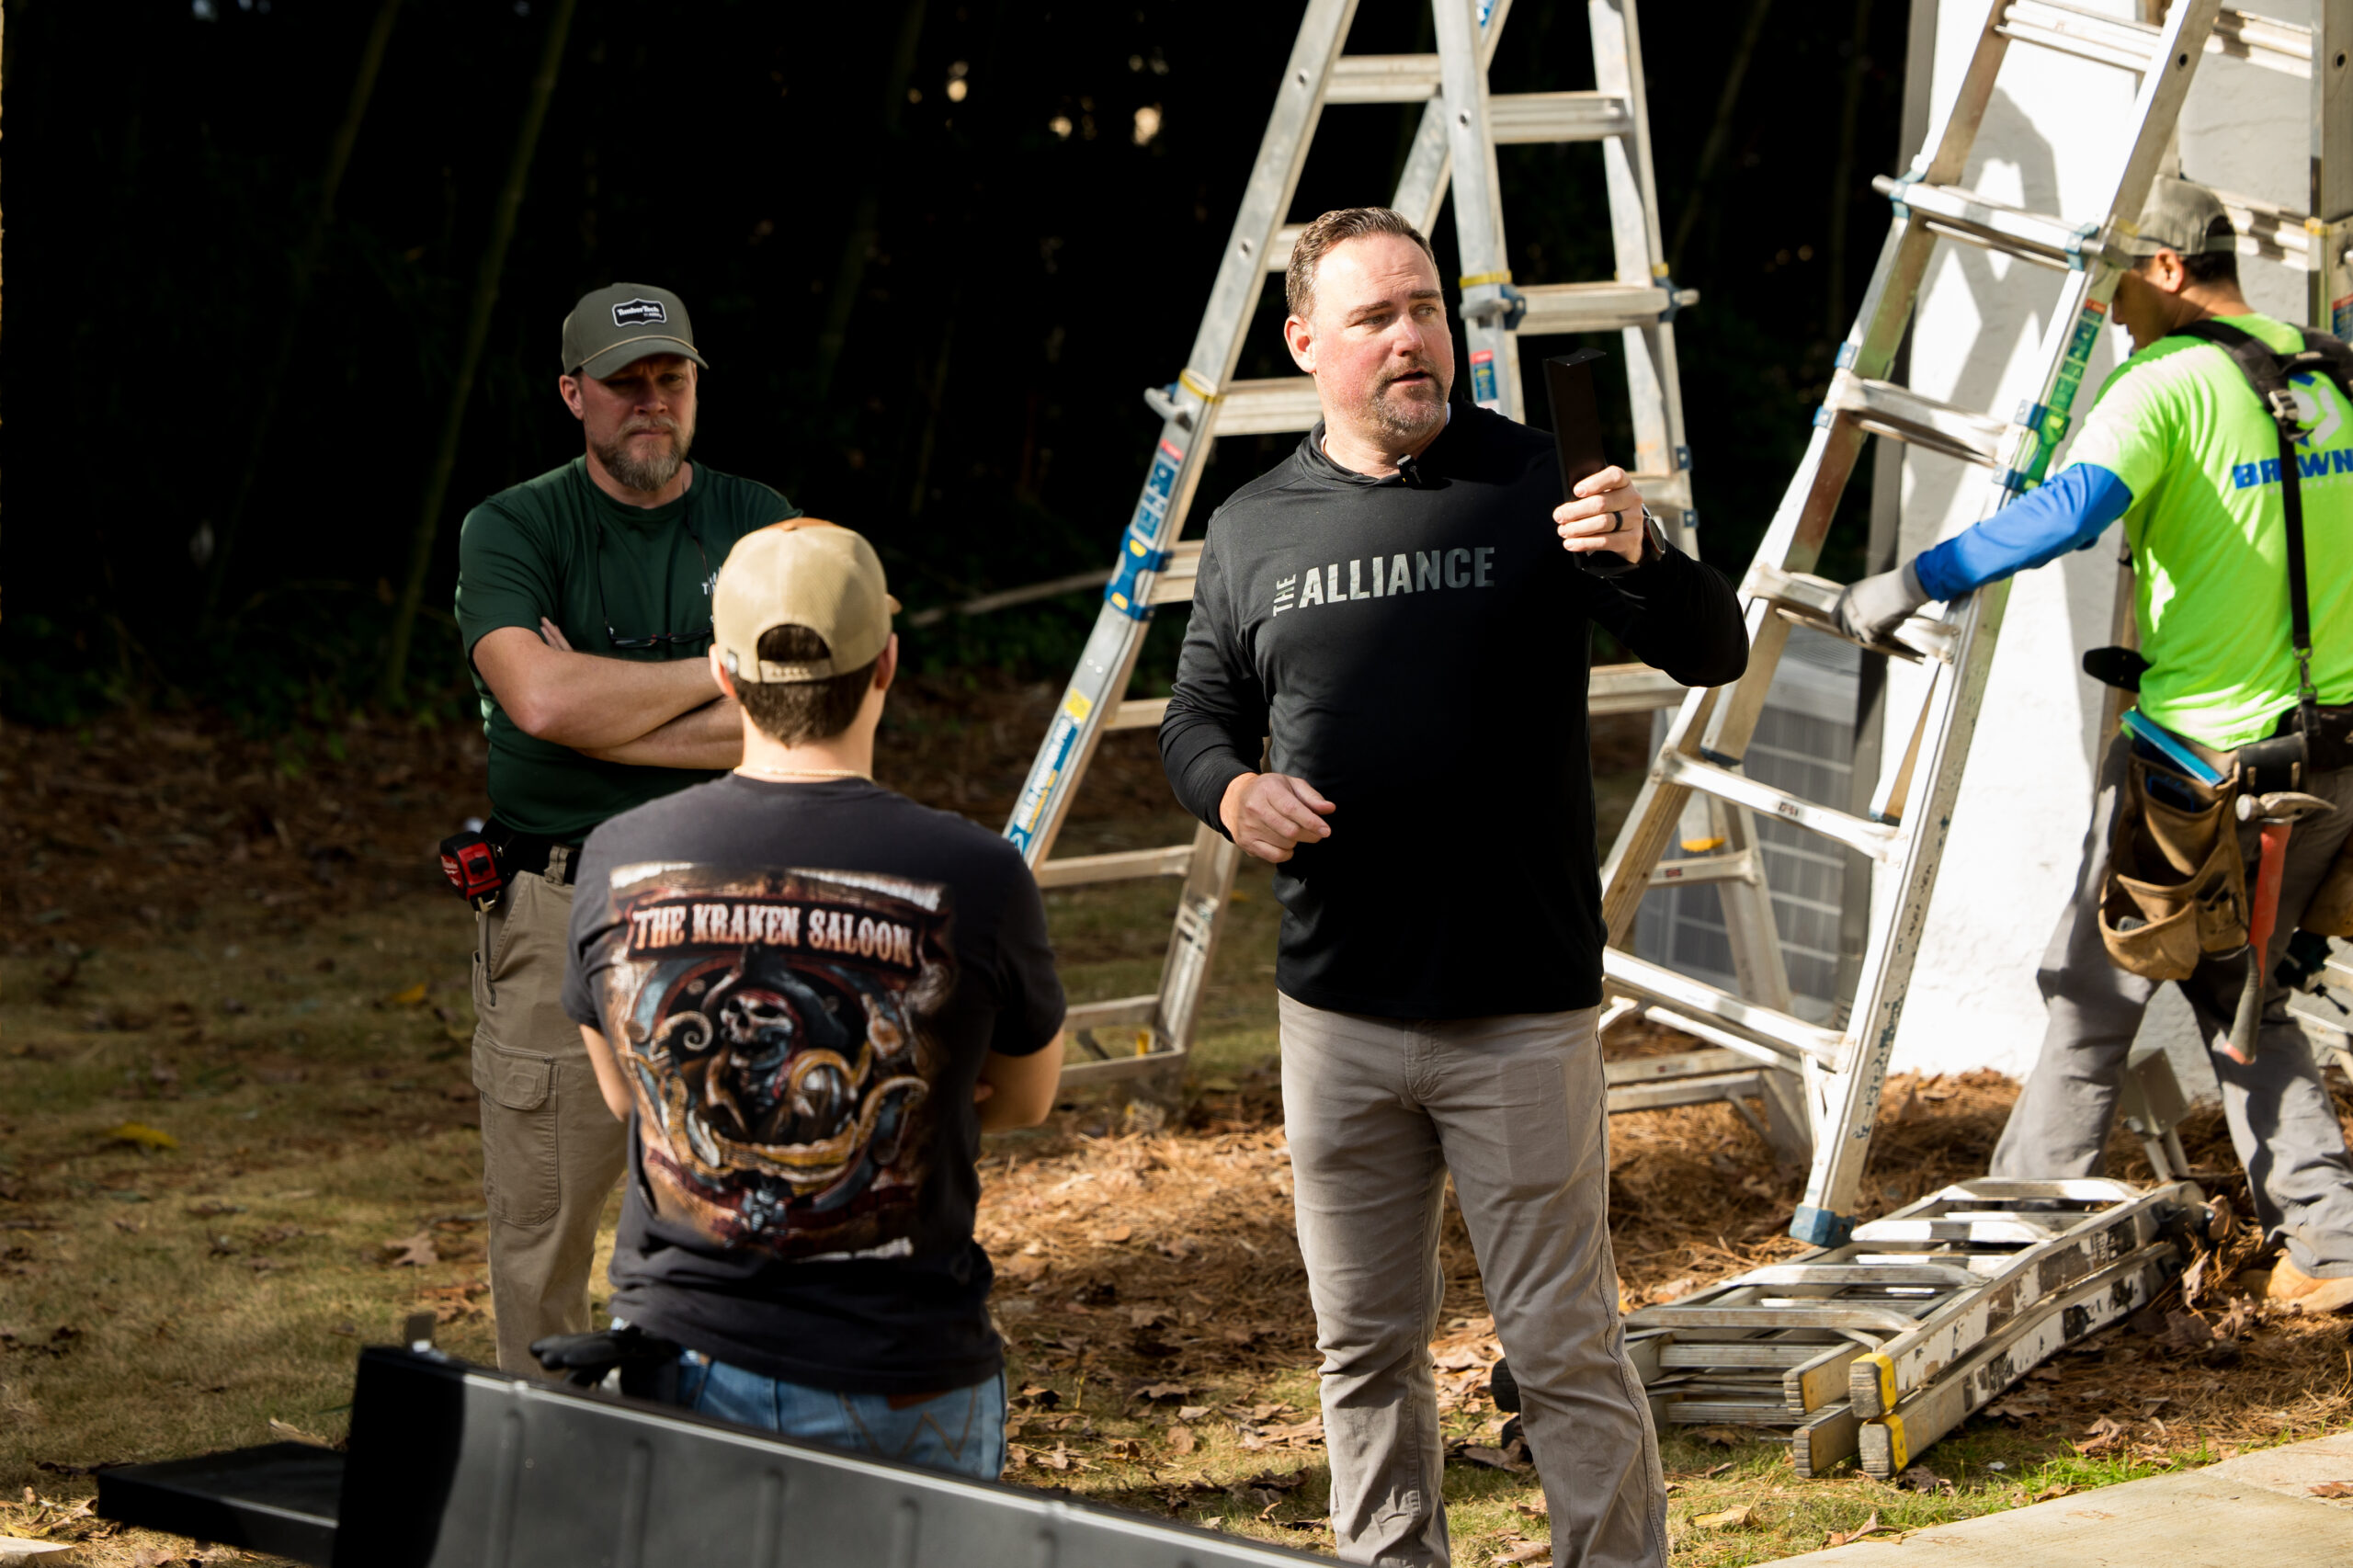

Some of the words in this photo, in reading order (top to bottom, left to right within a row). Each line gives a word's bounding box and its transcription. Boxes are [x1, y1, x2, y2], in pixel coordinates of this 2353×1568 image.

[2233, 449, 2353, 489] BRWN
[1273, 574, 1297, 617] THE
[1298, 547, 1495, 608] ALLIANCE
[632, 906, 687, 949] THE
[691, 903, 801, 947] KRAKEN
[808, 908, 914, 968] SALOON
